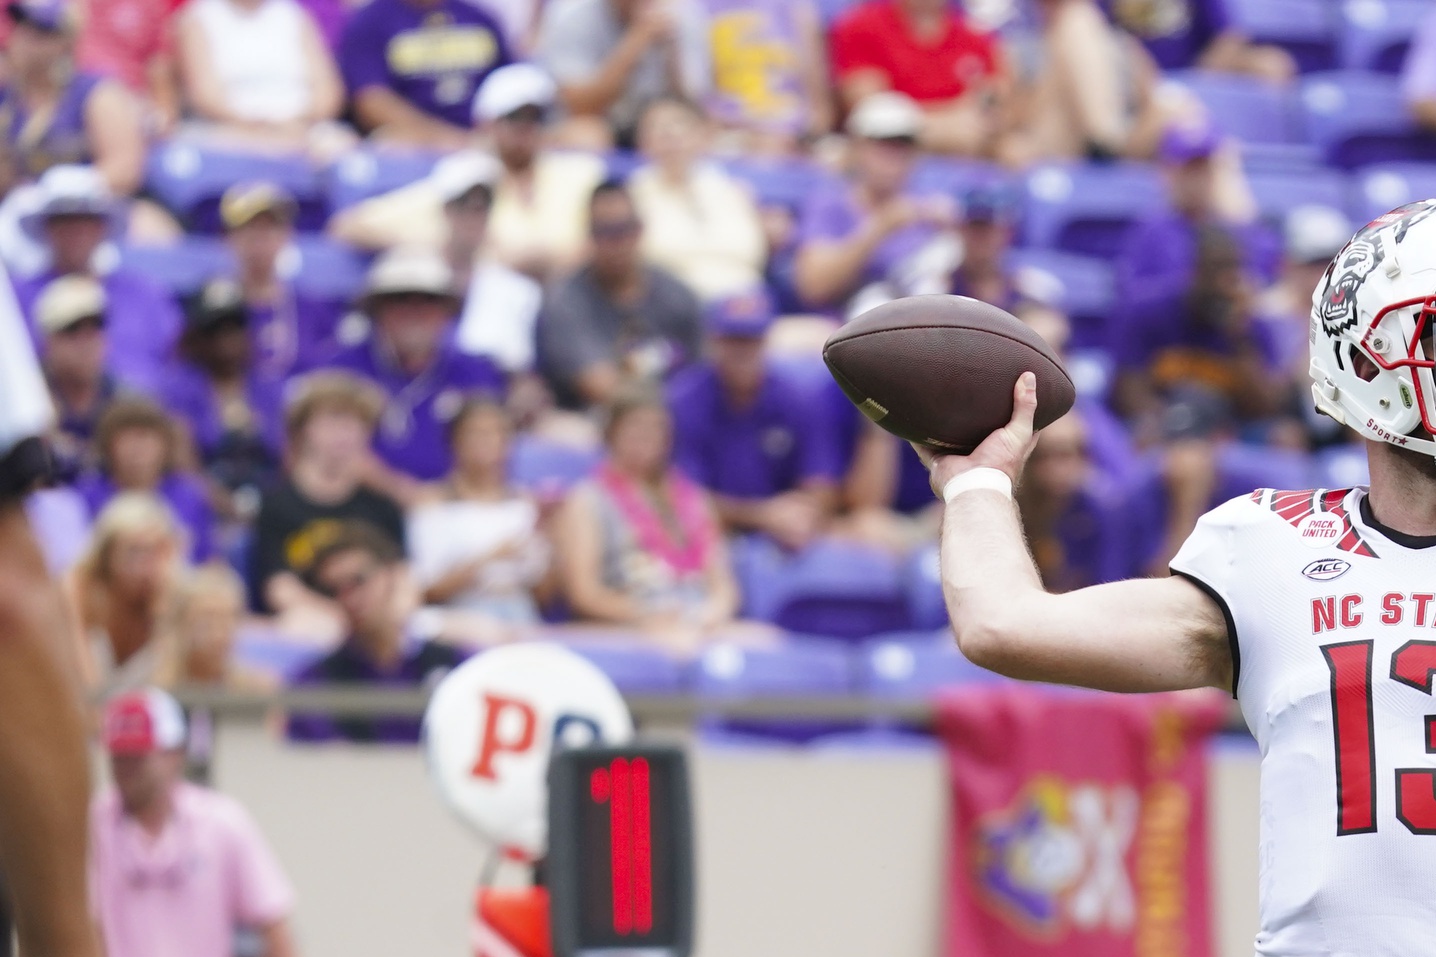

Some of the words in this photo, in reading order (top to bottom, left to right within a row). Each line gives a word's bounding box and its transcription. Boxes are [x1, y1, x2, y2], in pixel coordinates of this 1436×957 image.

[1309, 520, 1336, 528] PACK
[1302, 529, 1337, 538] UNITED
[1309, 561, 1345, 573] ACC
[1309, 593, 1364, 636] NC
[590, 756, 652, 935] 1
